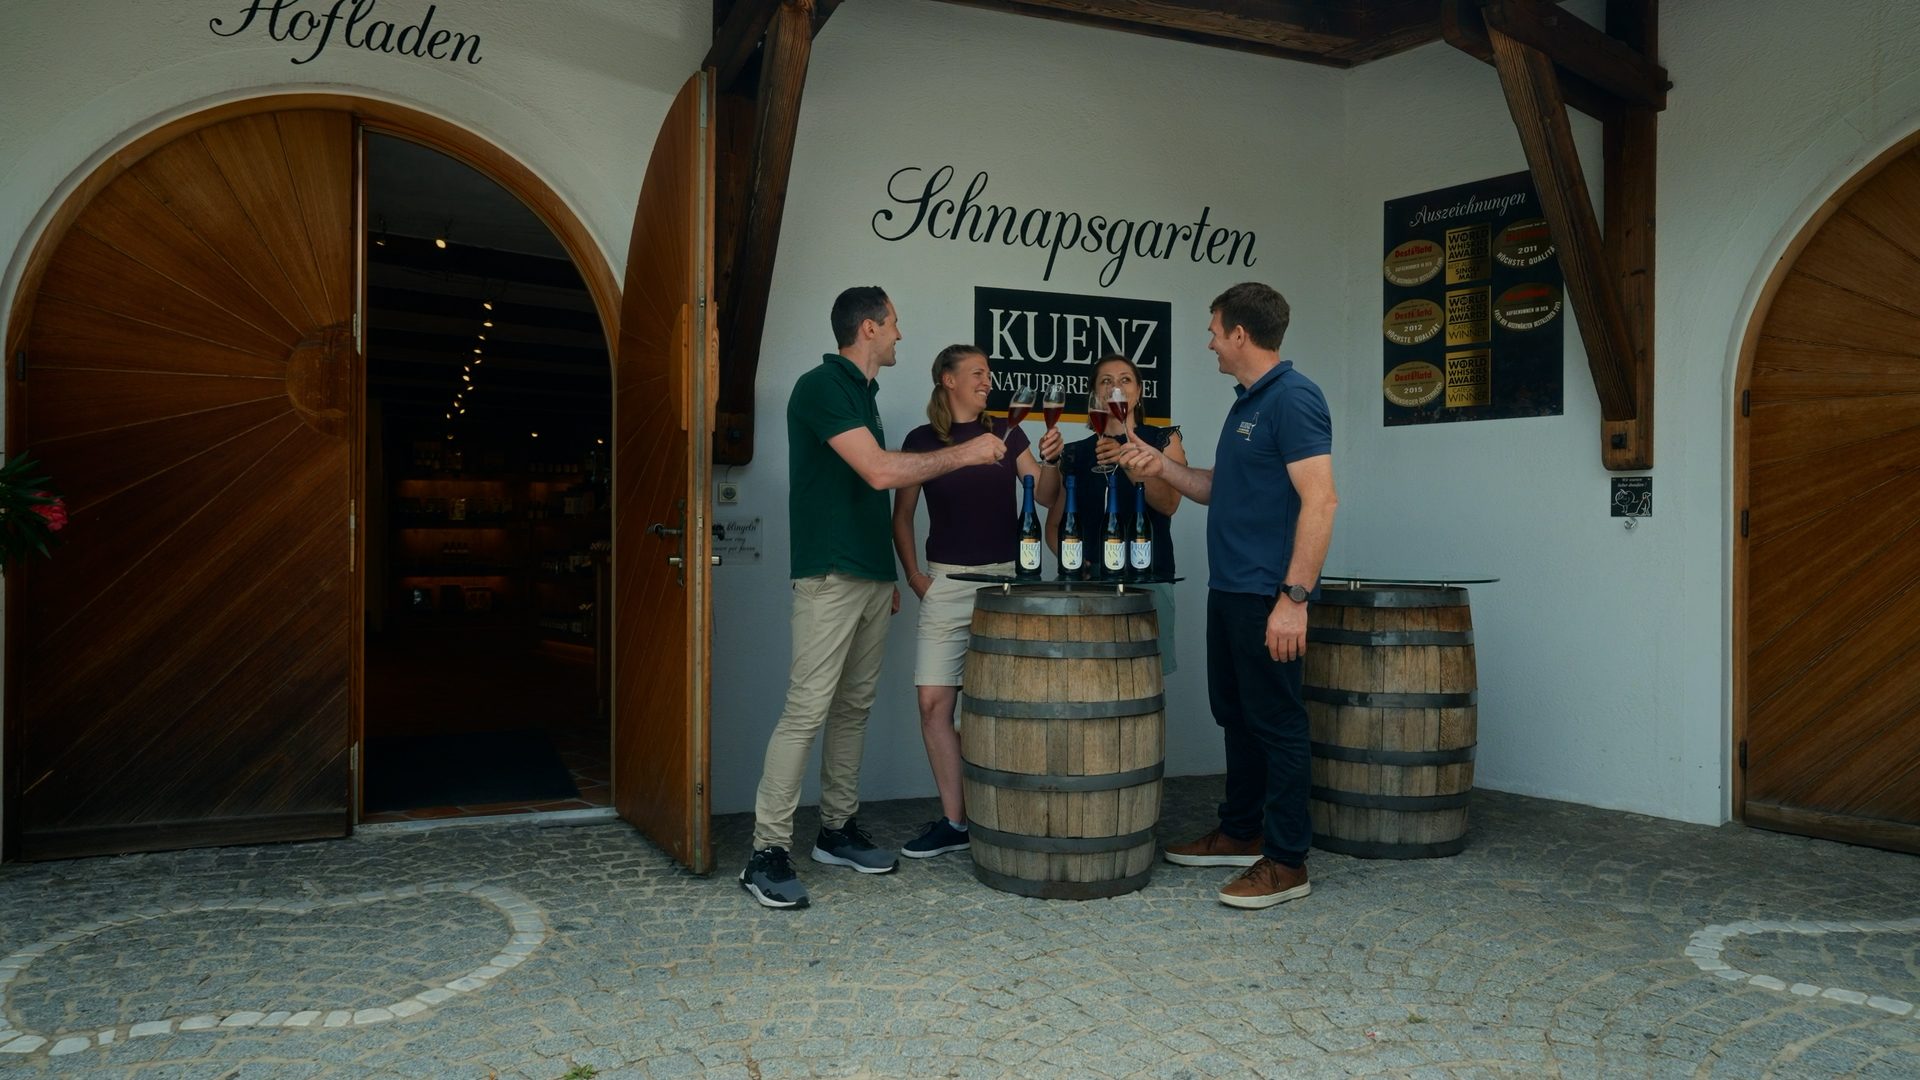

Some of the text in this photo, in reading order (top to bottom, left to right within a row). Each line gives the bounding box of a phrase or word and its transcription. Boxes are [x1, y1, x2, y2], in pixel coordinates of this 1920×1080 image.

[209, 0, 482, 65] Hofladen
[1409, 191, 1527, 227] Auszeichnungen
[872, 165, 1258, 288] Schnapsgarten
[1518, 245, 1537, 254] 2011
[1449, 294, 1487, 306] WORLD
[1449, 312, 1487, 322] AWARDS
[1404, 324, 1423, 332] 2012
[1449, 327, 1487, 339] WINNER
[988, 309, 1159, 369] KUENZ
[1449, 358, 1487, 369] WORLD
[1449, 367, 1487, 376] WHISKIES
[989, 371, 1158, 399] NATURBREEI
[1449, 375, 1487, 384] AWARDS
[1403, 386, 1423, 394] 2015
[1448, 391, 1488, 402] WINNER
